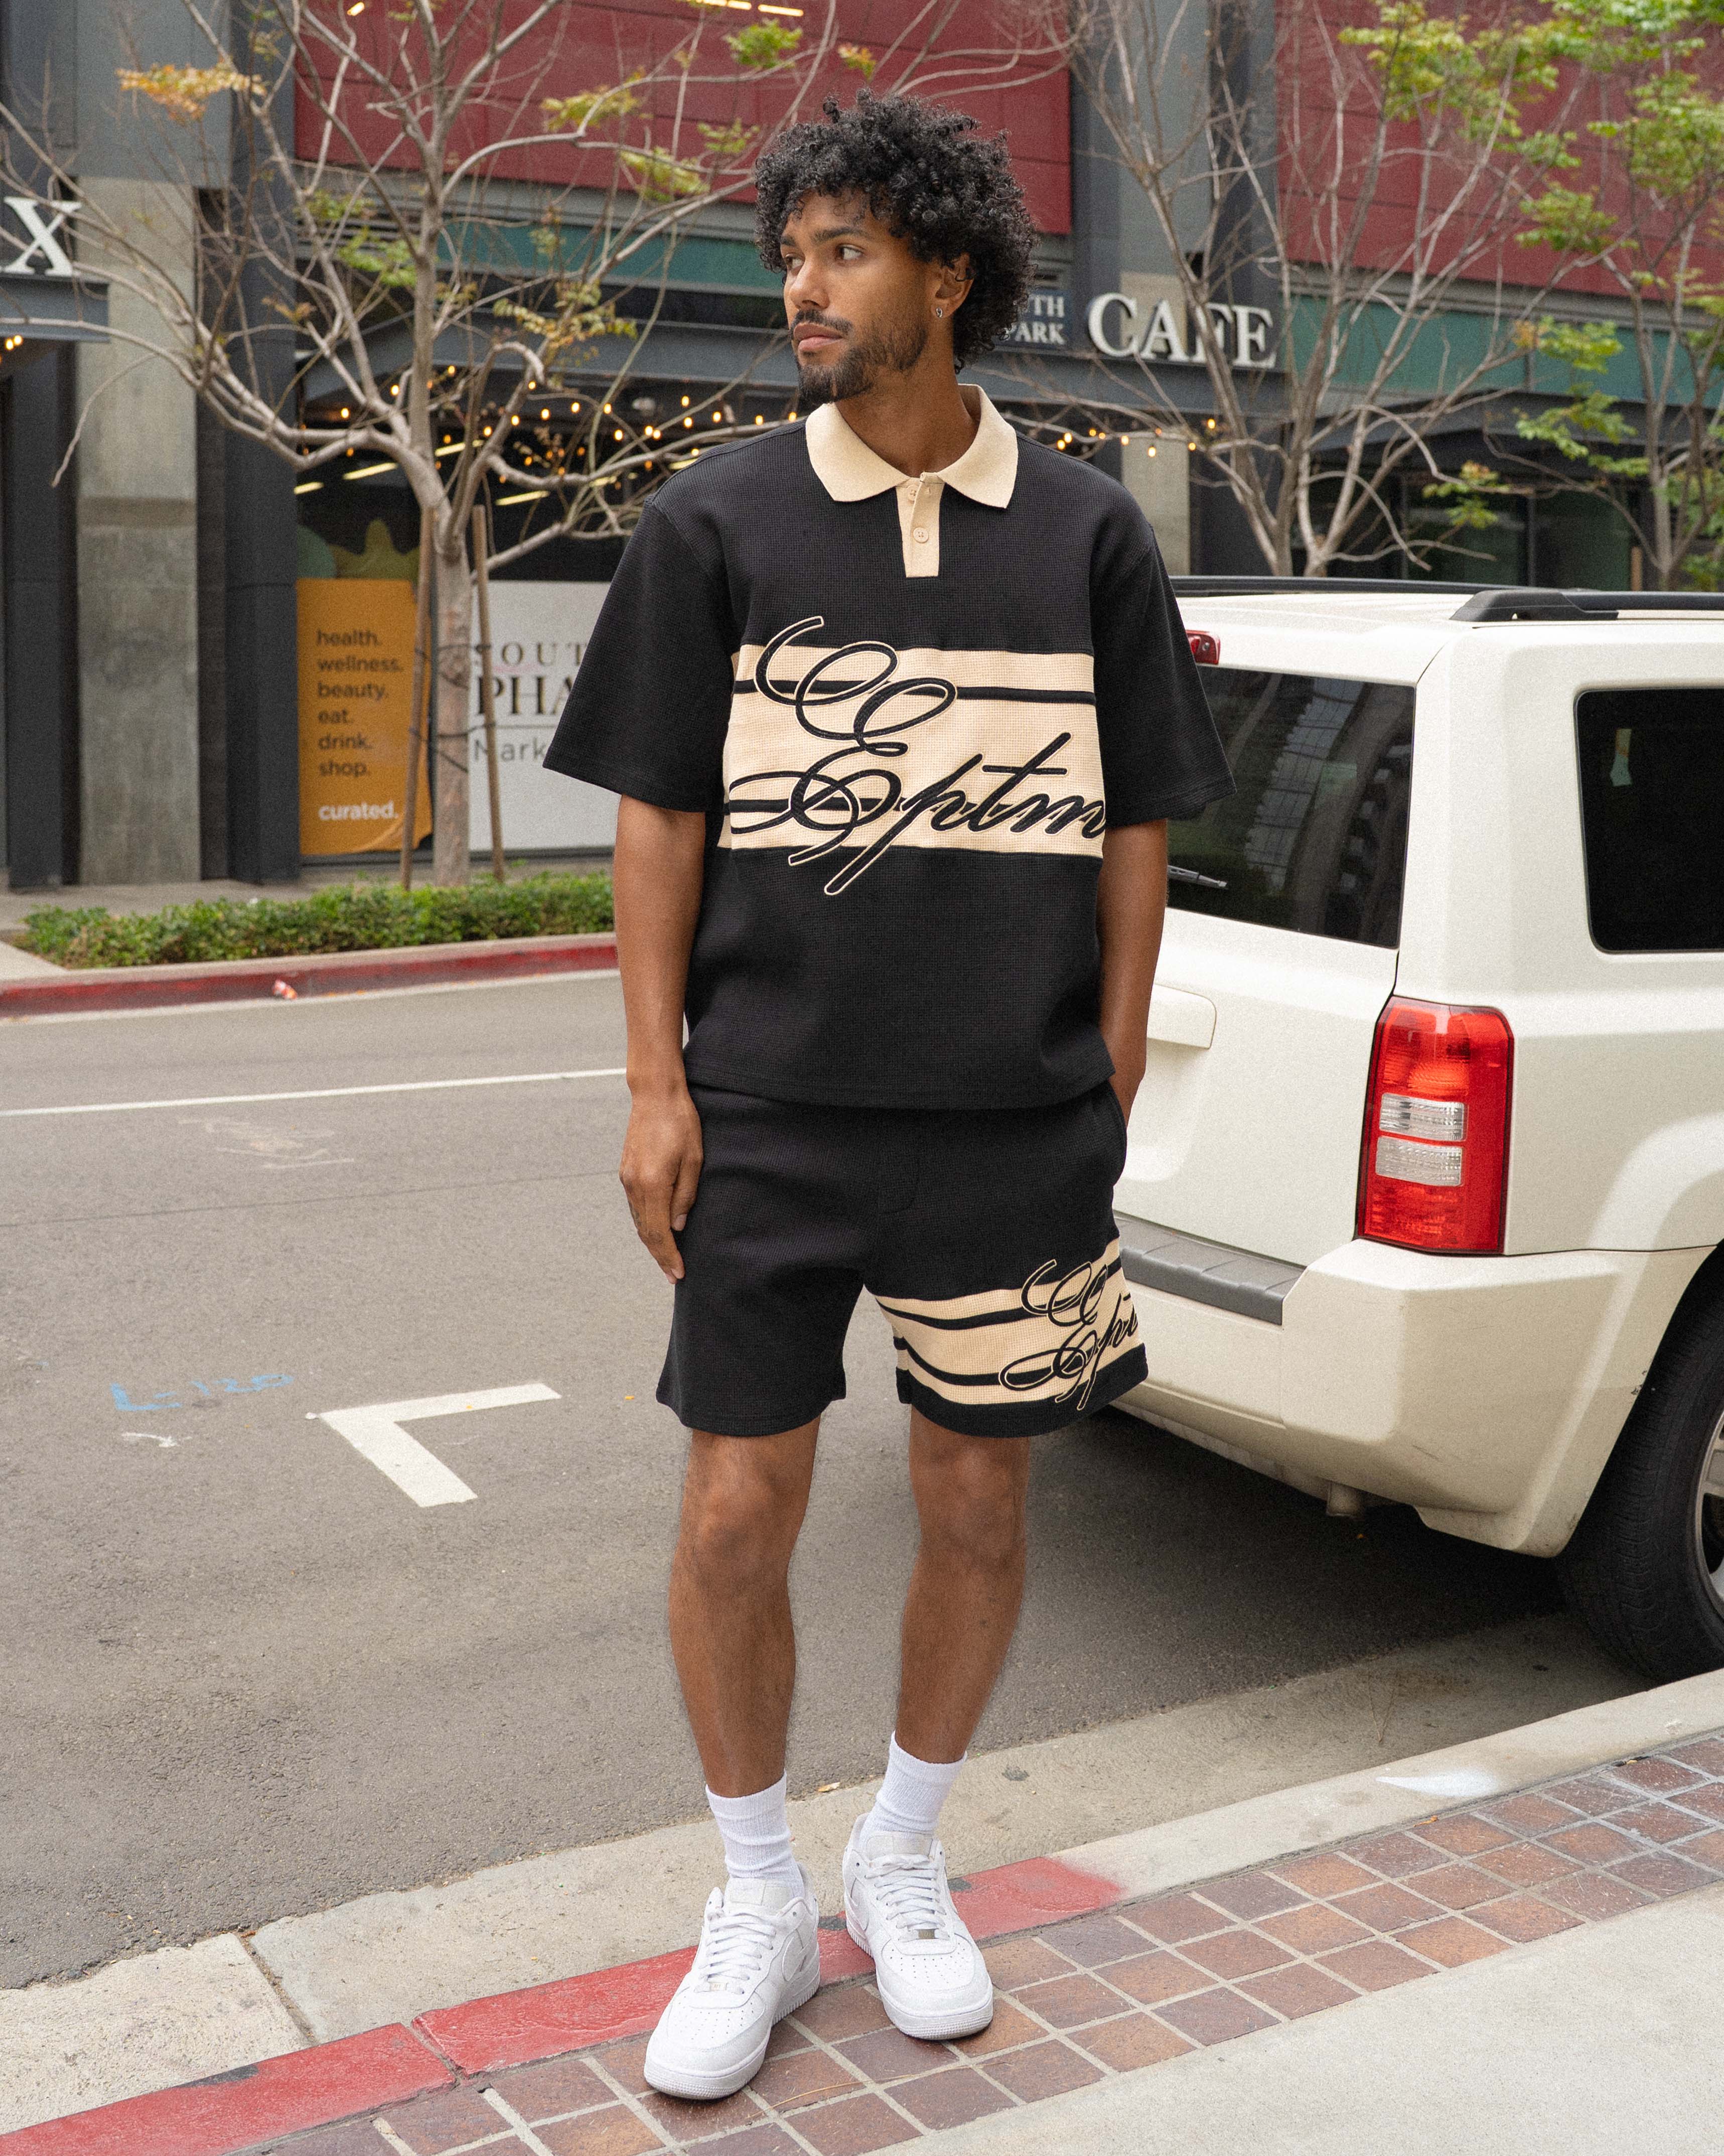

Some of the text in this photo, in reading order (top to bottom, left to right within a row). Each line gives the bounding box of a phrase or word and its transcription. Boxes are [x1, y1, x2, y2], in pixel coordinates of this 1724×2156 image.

[1020, 294, 1064, 318] TH
[1088, 292, 1277, 369] CAFE
[317, 630, 381, 646] health.
[318, 655, 403, 671] wellness.
[318, 683, 389, 701] beauty.
[318, 709, 353, 723] eat.
[319, 732, 372, 749] drink.
[320, 760, 370, 777] shop.
[318, 800, 399, 820] curated.
